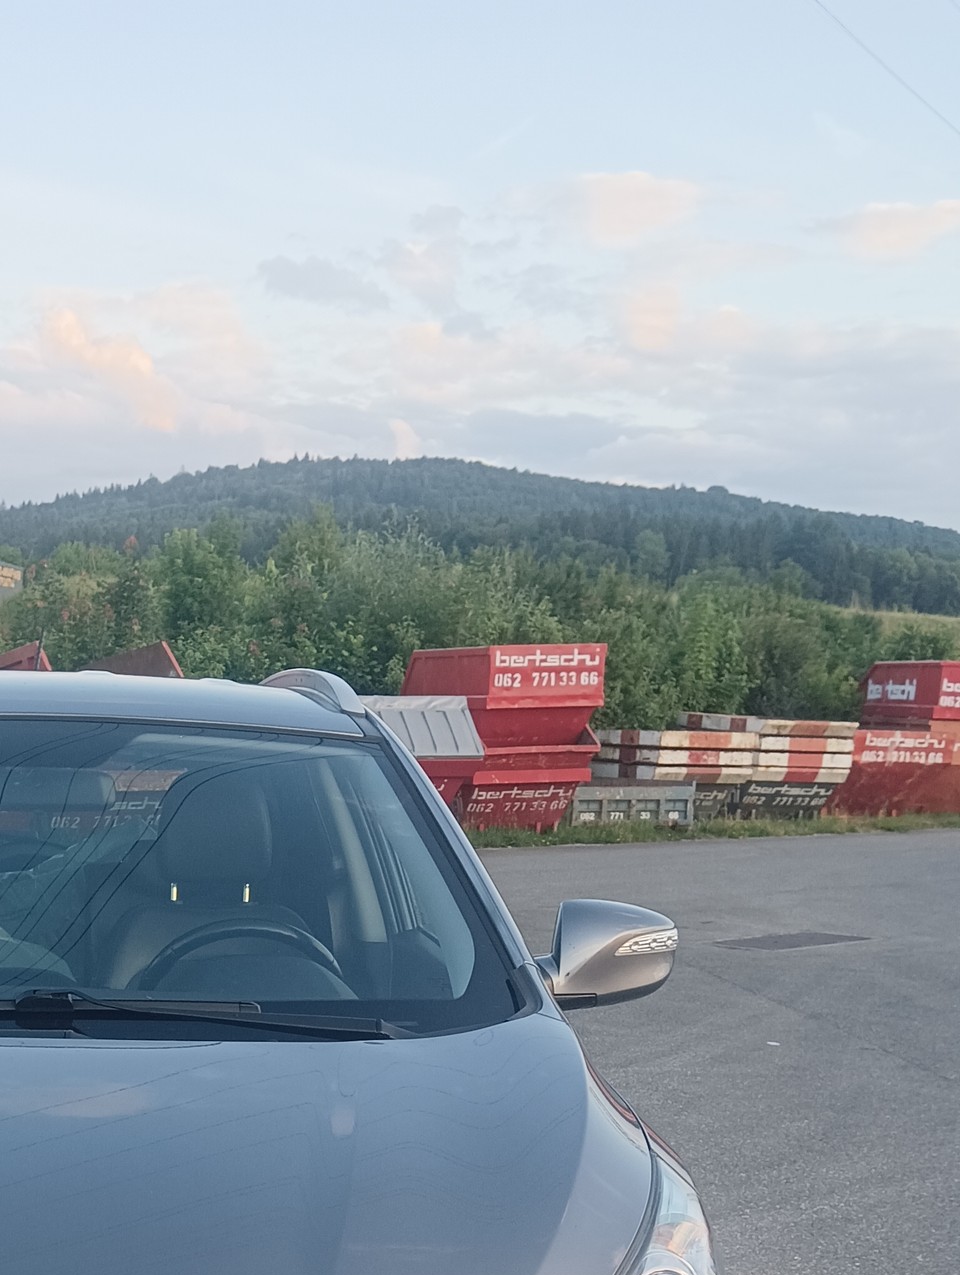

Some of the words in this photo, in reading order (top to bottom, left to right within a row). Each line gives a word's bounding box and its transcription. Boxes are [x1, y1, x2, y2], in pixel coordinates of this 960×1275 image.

[495, 647, 600, 667] bertschi
[494, 673, 522, 688] 062
[532, 672, 556, 686] 771
[559, 671, 577, 686] 33
[580, 671, 599, 685] 66
[471, 783, 575, 799] bertschi
[467, 802, 494, 812] 062
[504, 801, 527, 812] 771
[530, 800, 547, 811] 33
[550, 799, 568, 810] 66
[610, 812, 624, 820] 771
[640, 811, 650, 820] 33
